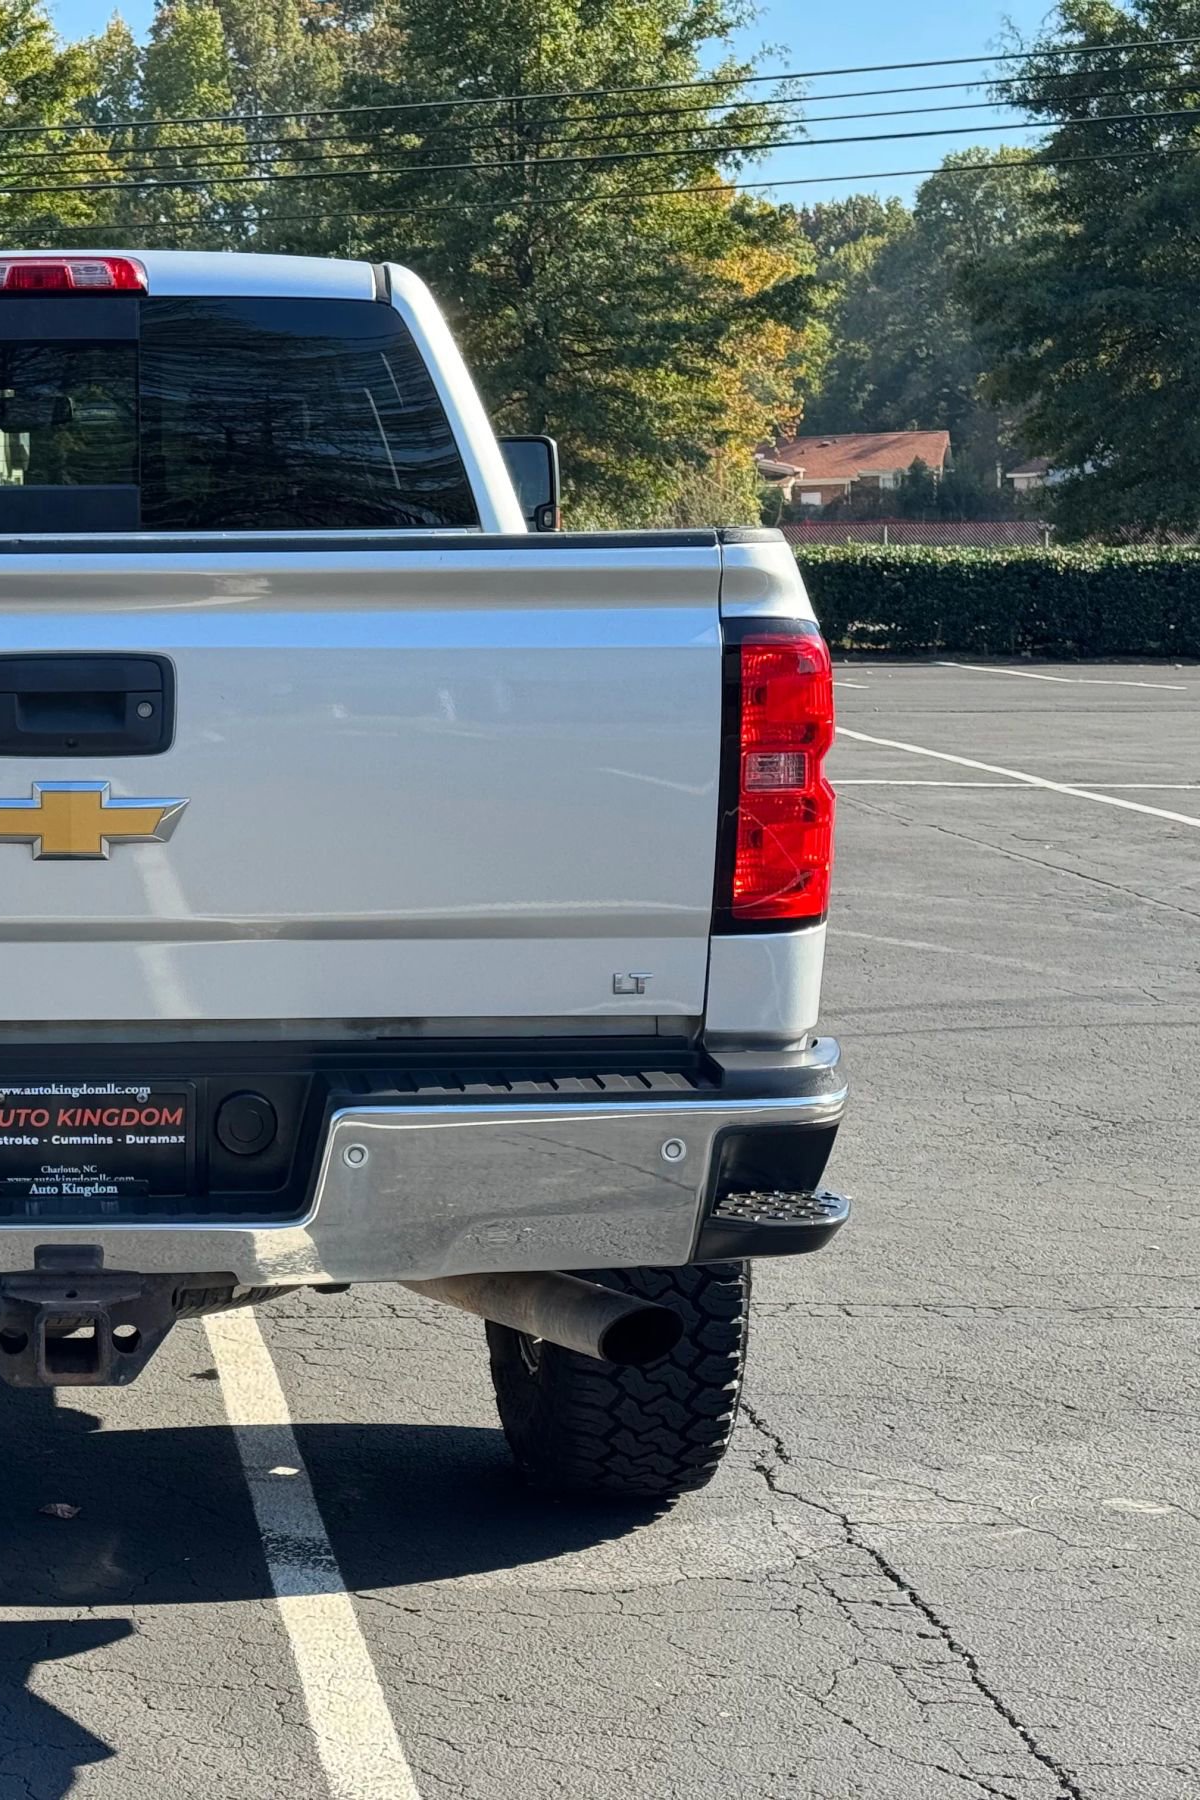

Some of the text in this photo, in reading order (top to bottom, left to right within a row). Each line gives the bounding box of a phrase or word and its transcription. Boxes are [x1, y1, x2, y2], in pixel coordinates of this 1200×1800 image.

[612, 973, 654, 995] LT
[56, 1107, 184, 1127] KINGDOM
[51, 1134, 114, 1145] Cummins
[125, 1134, 186, 1144] Duramax
[82, 1165, 98, 1173] NC
[29, 1182, 119, 1197] Auto Kingdom
